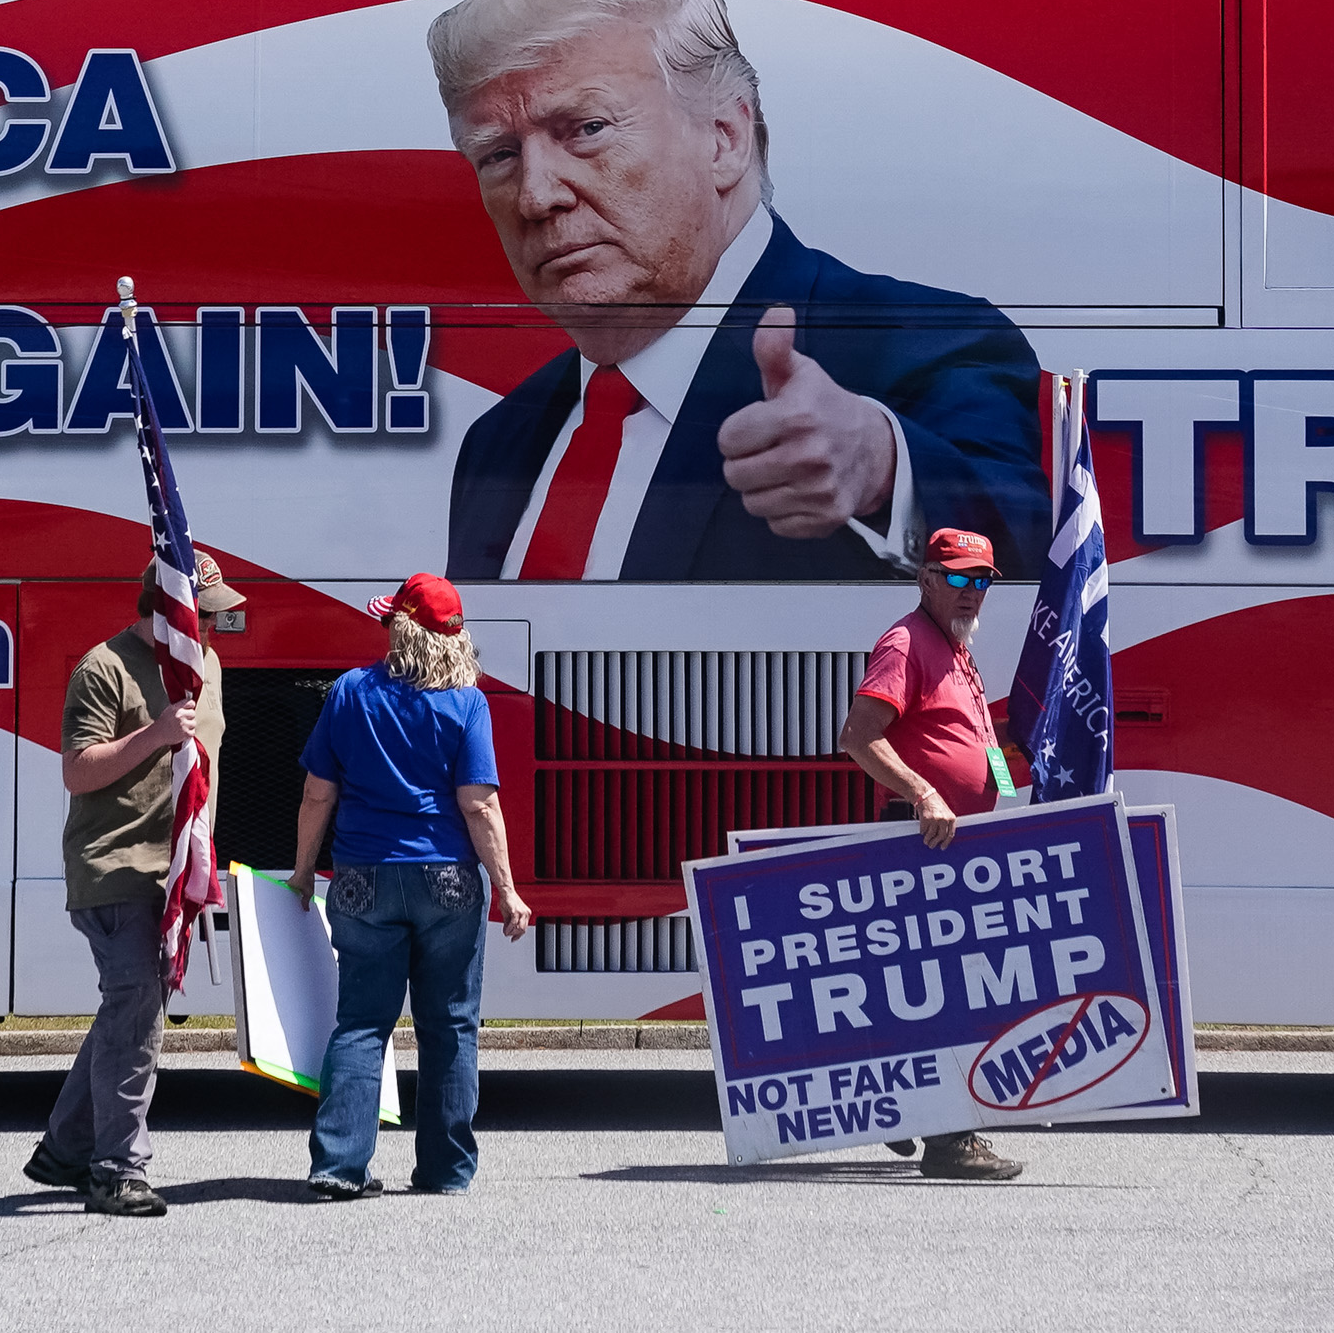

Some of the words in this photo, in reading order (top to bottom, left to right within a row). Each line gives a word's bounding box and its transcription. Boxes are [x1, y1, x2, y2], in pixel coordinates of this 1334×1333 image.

[733, 895, 751, 931] I
[798, 841, 1082, 920] SUPPORT
[740, 887, 1092, 977] PRESIDENT
[741, 933, 1108, 1043] TRUMP
[727, 1073, 818, 1118] NOT
[830, 1053, 942, 1098] FAKE
[979, 999, 1138, 1104] MEDIA
[776, 1096, 902, 1145] NEWS
